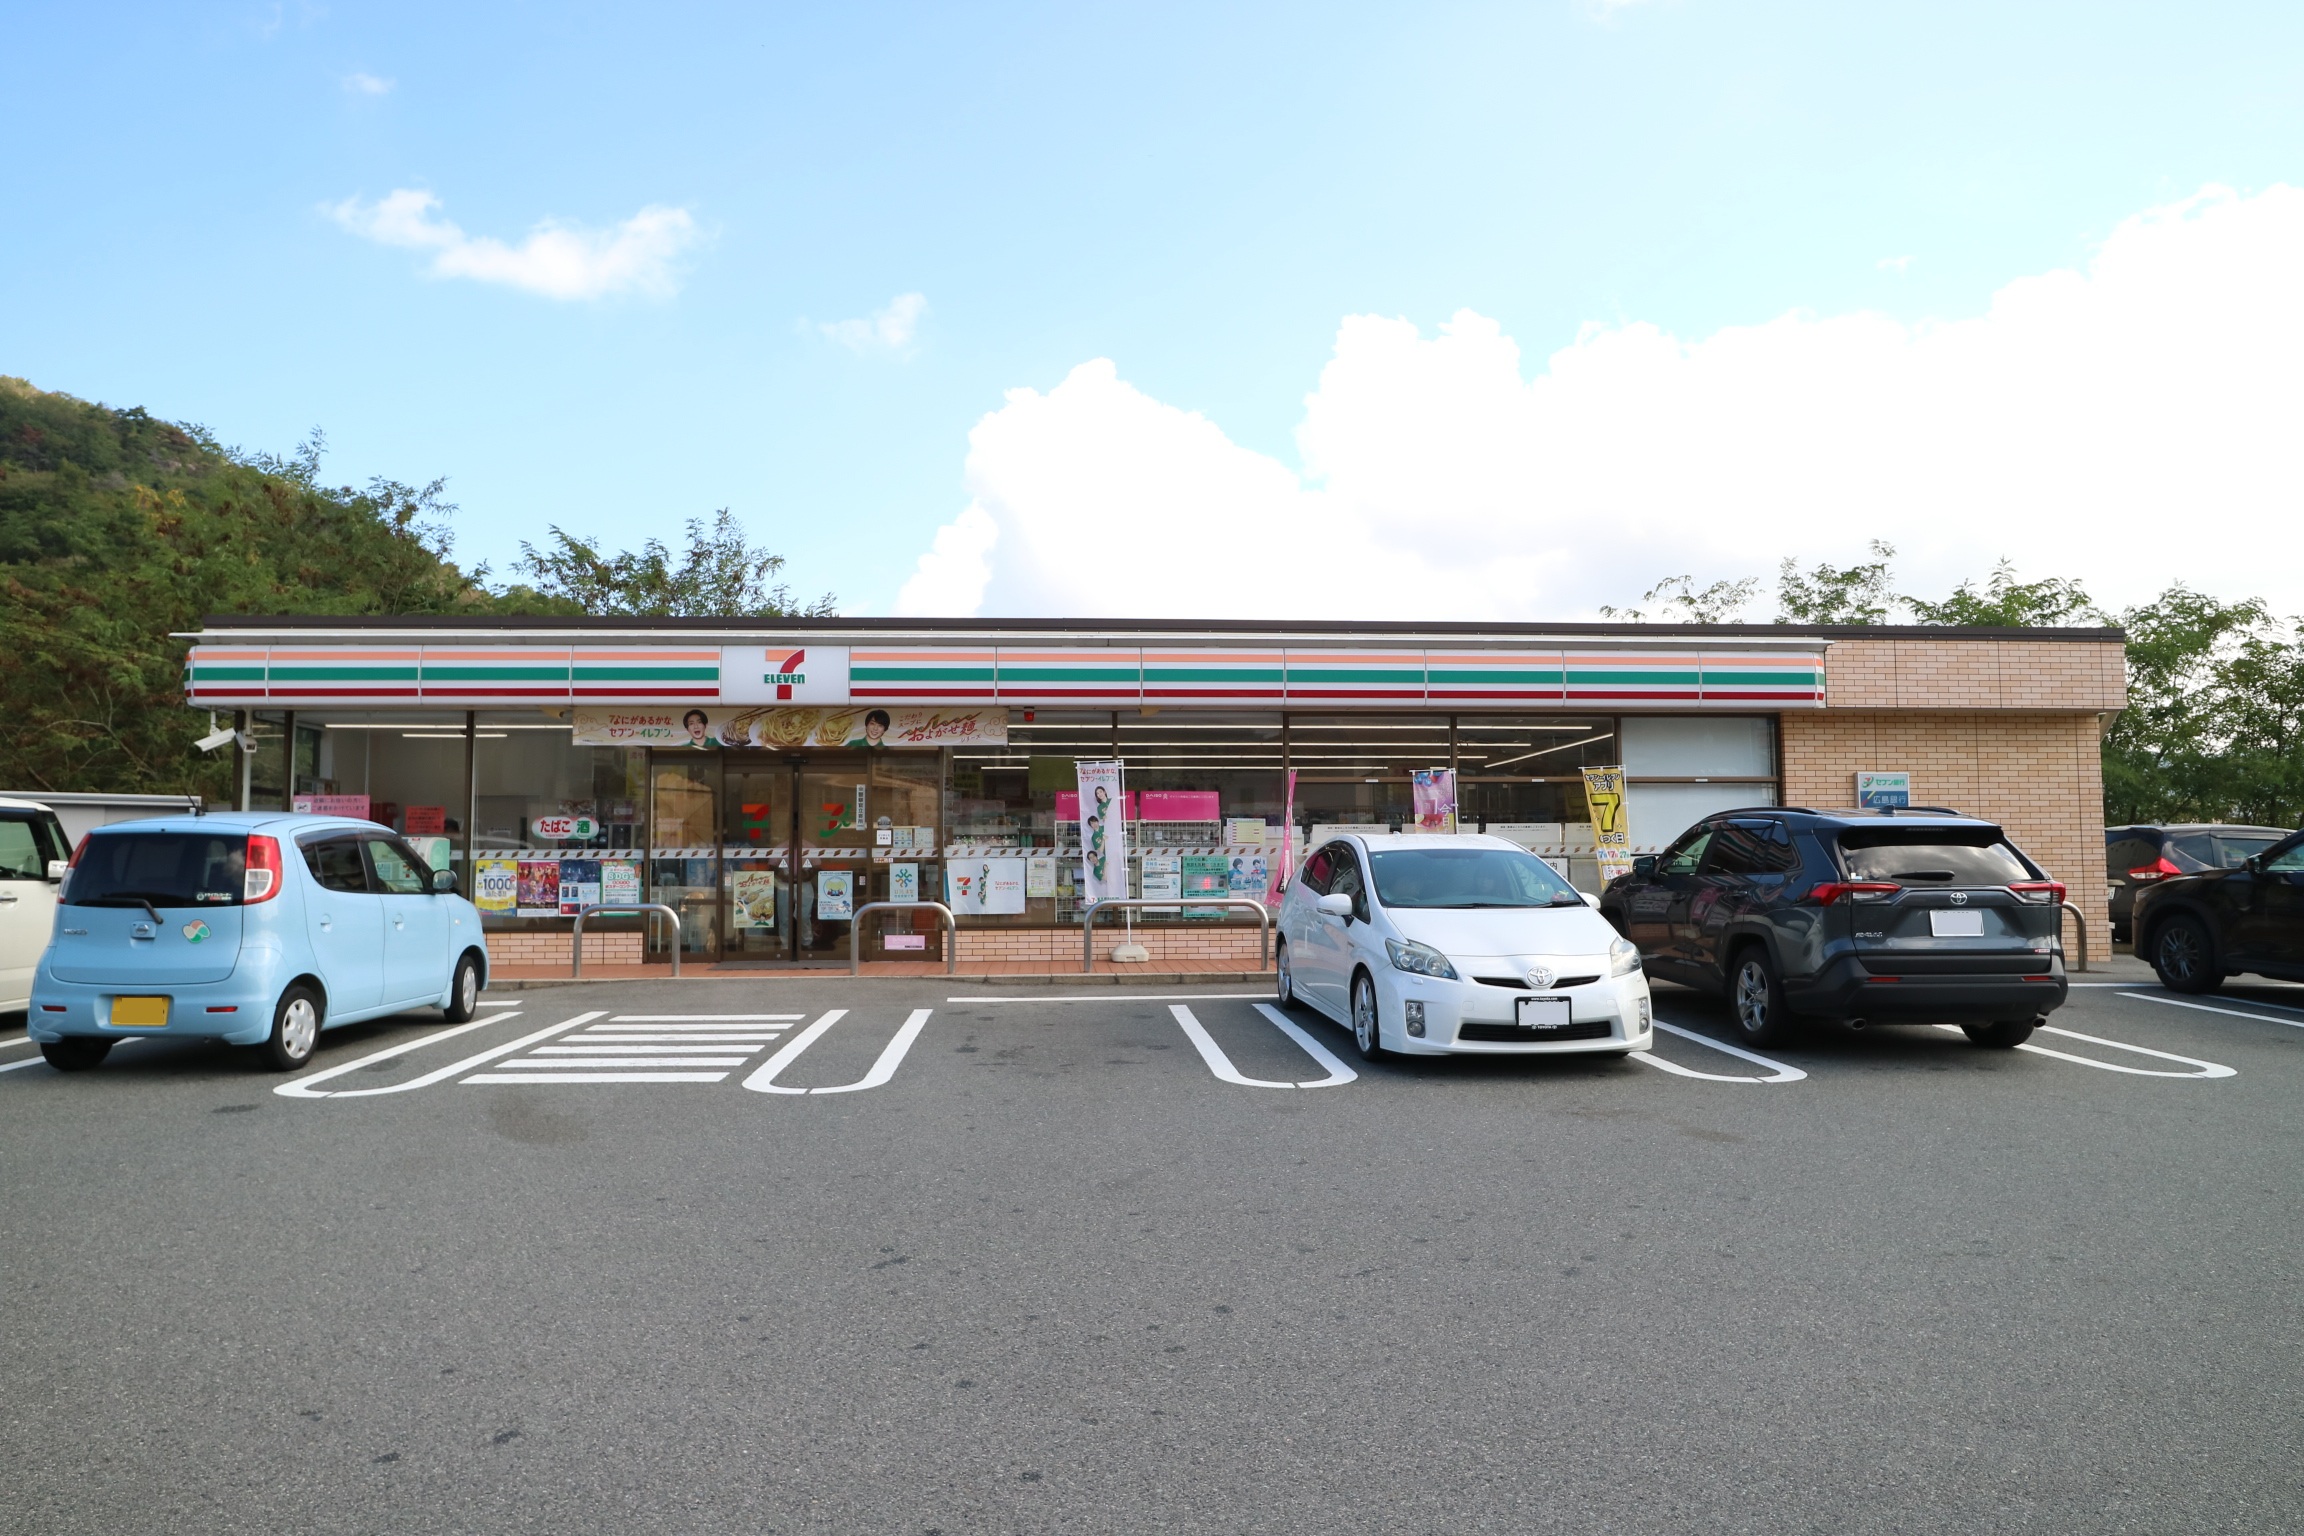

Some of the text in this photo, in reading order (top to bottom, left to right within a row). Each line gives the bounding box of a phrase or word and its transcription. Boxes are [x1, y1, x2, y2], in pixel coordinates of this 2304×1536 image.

[765, 649, 805, 700] 7
[1594, 781, 1614, 790] アプリ
[1873, 796, 1906, 804] 広島銀行
[1590, 793, 1620, 832] 7
[540, 820, 591, 833] たばこ 酒
